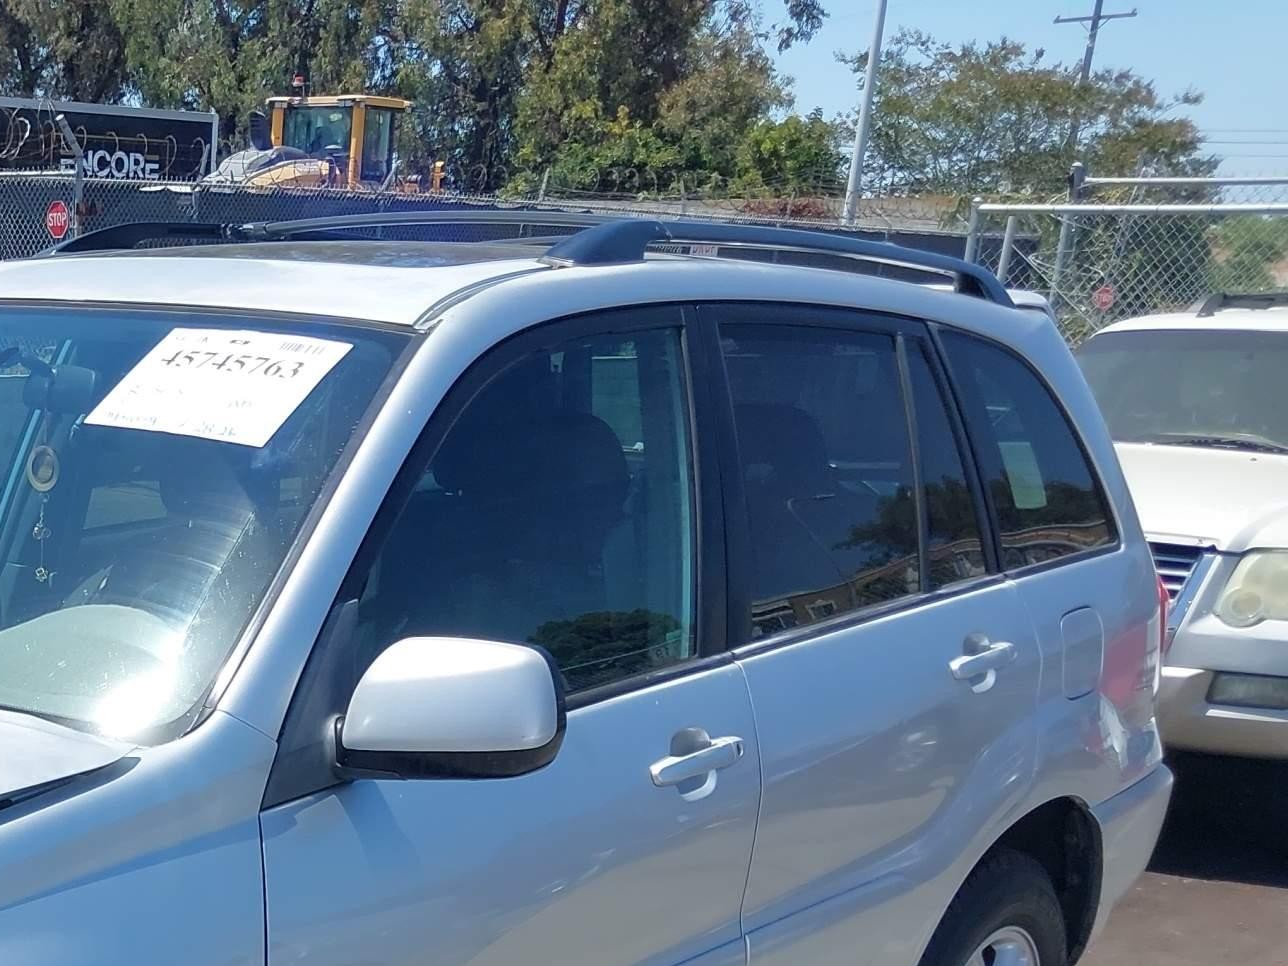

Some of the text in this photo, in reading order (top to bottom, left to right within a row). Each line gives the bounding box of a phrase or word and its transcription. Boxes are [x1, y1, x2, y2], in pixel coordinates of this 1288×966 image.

[60, 150, 160, 180] ENCORE
[48, 212, 67, 227] STOP
[161, 349, 305, 379] 45745763
